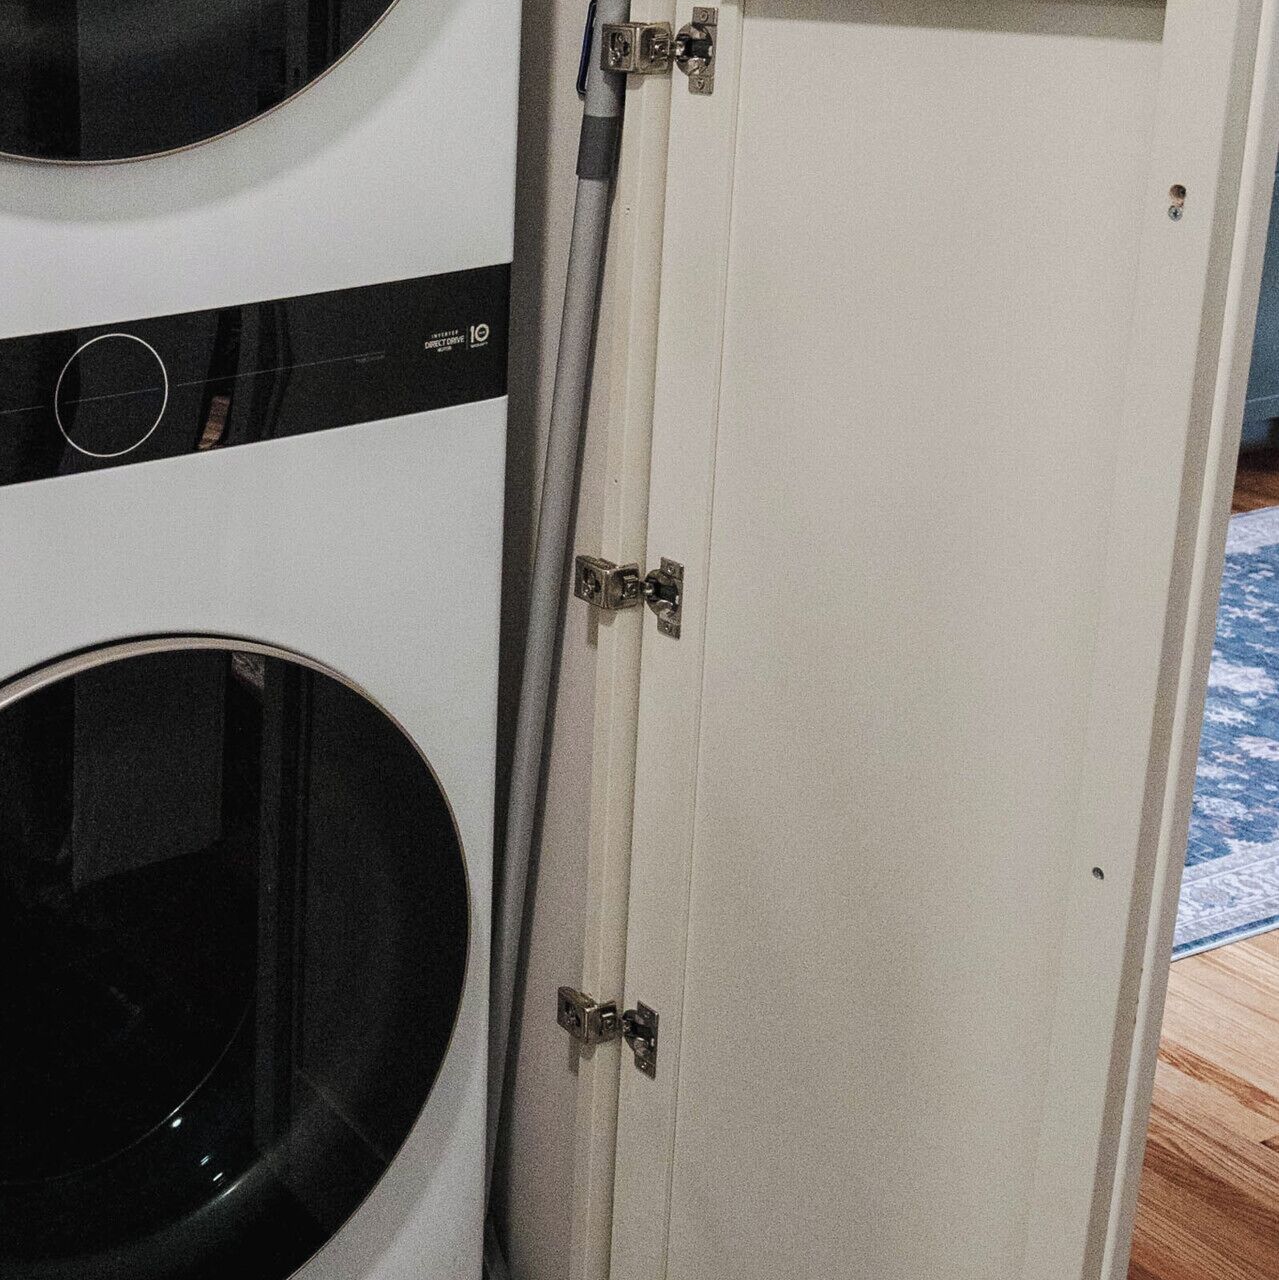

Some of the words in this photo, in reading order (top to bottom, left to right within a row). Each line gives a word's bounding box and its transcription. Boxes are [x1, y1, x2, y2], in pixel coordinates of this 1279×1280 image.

[424, 338, 447, 350] DIRECT
[447, 335, 465, 346] DRIVE
[470, 323, 490, 344] 10
